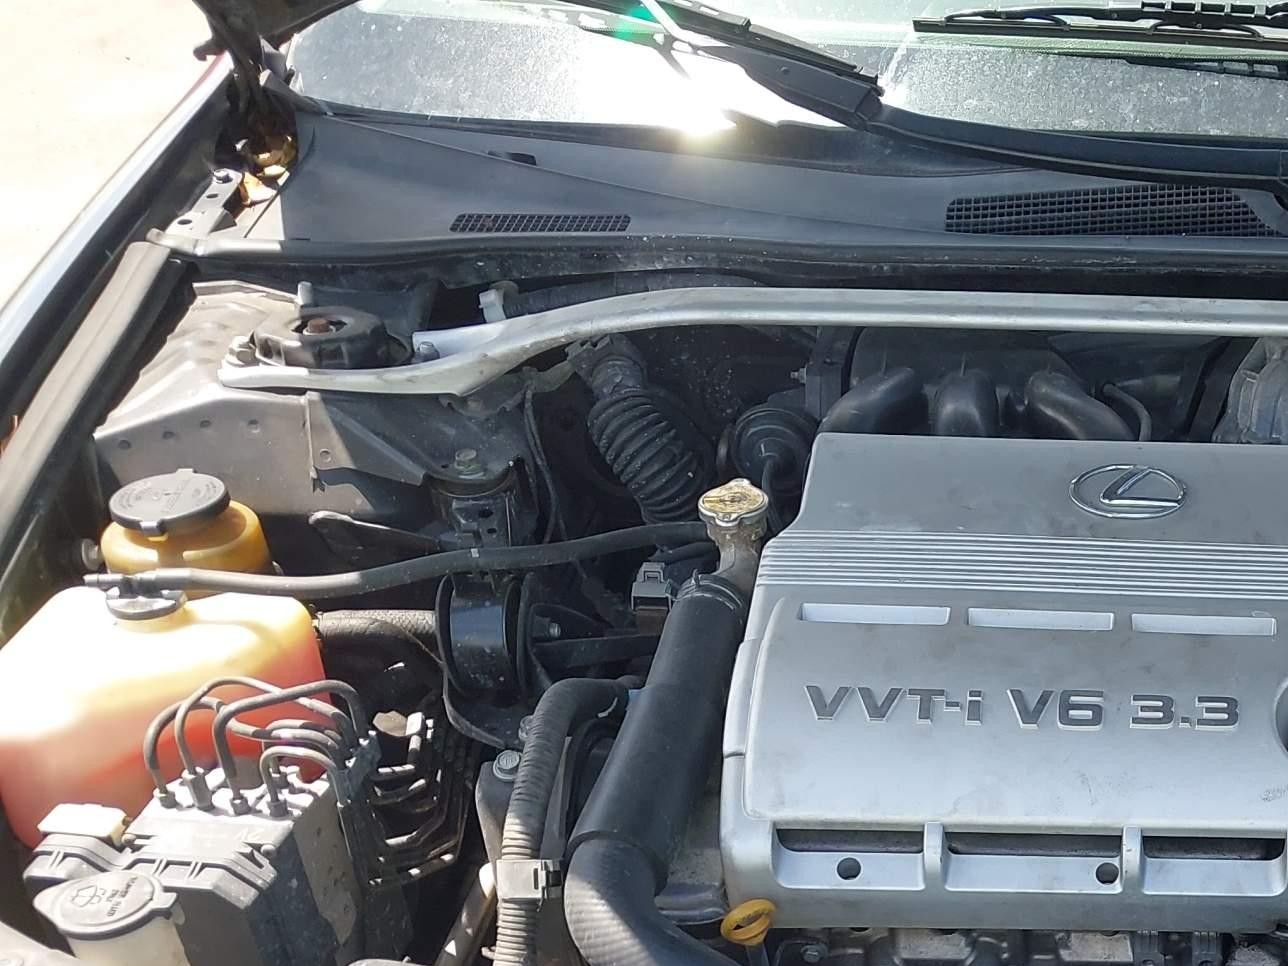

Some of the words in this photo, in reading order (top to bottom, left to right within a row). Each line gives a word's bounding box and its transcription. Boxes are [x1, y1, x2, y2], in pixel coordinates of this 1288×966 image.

[804, 685, 985, 725] VVT-i
[1007, 689, 1105, 729] V6
[1129, 694, 1240, 731] 3.3
